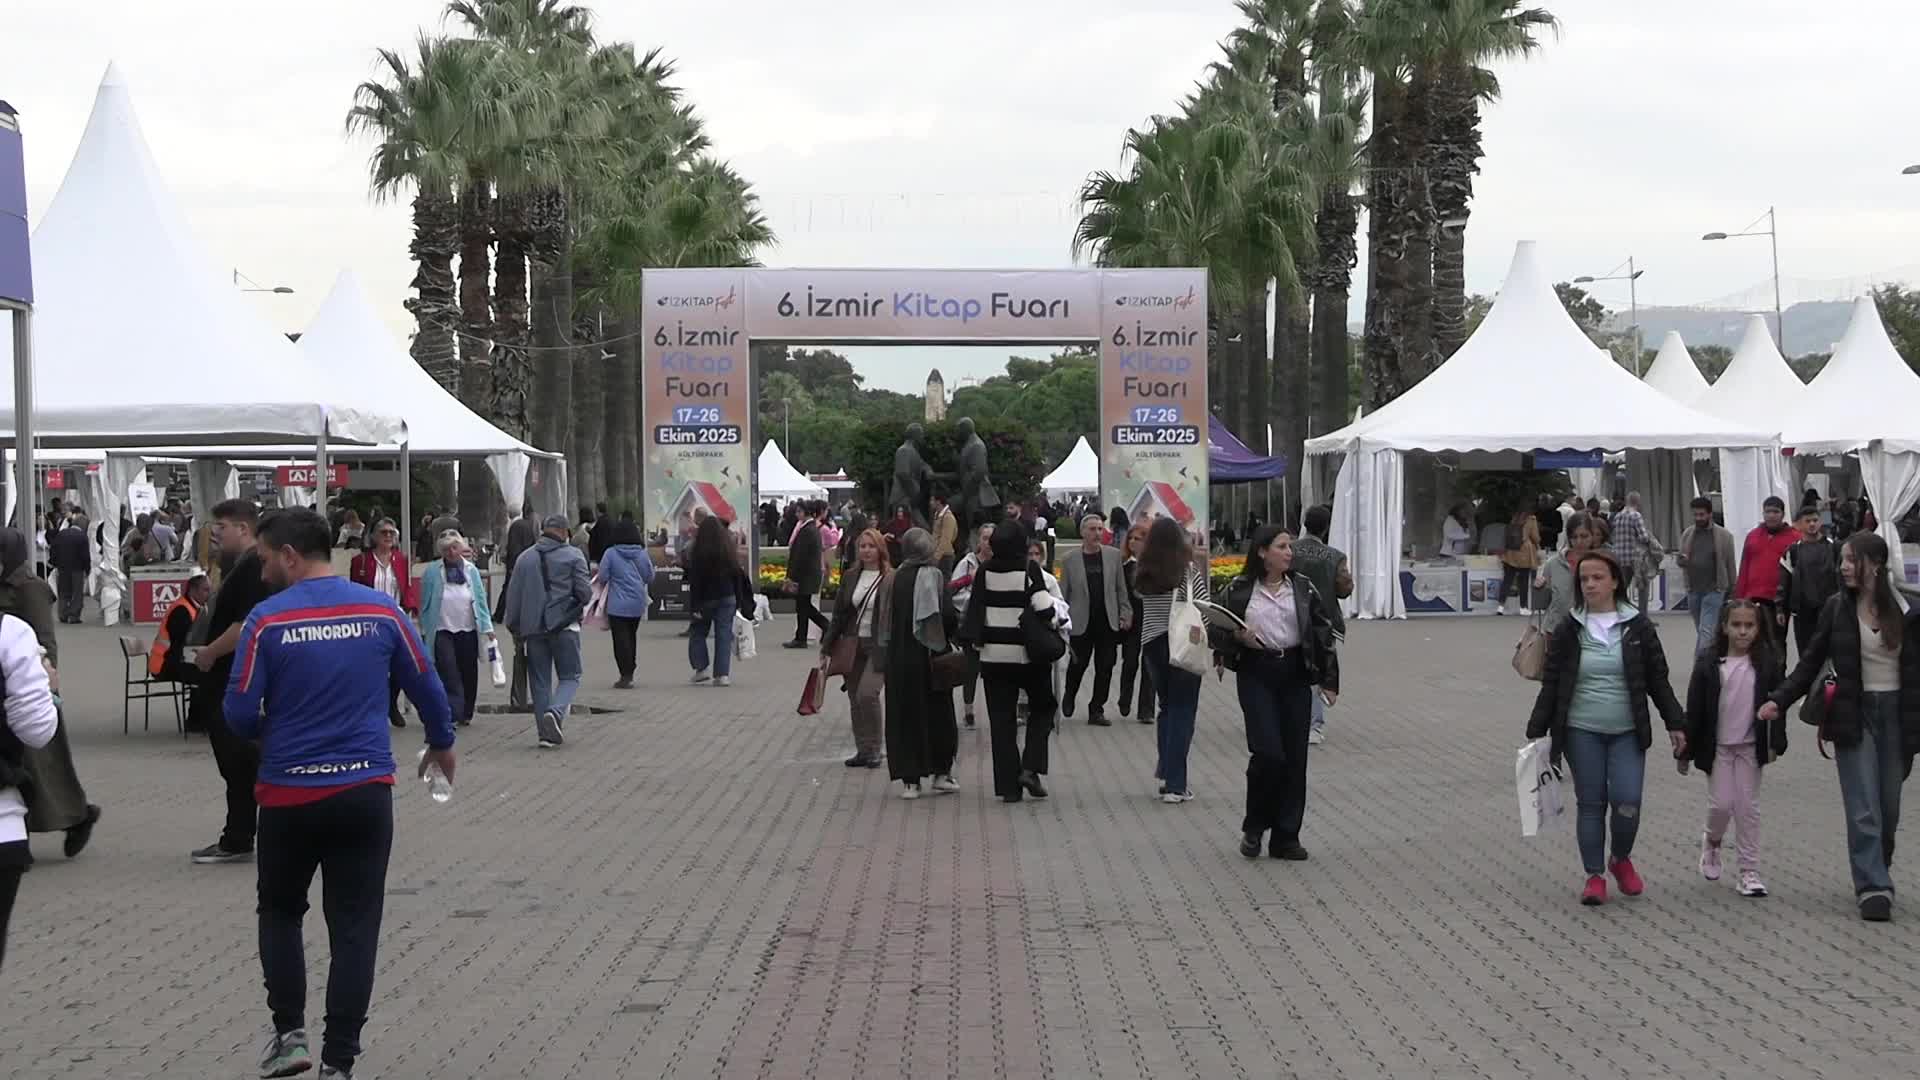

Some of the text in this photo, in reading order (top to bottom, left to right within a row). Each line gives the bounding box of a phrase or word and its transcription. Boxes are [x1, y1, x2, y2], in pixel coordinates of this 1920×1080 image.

[777, 285, 1069, 324] 6. İzmir Kitap Fuarı
[654, 320, 739, 346] 6. İzmir
[1112, 320, 1198, 346] 6. İzmir
[661, 351, 732, 375] Kitap
[1120, 351, 1191, 375] Kitap
[666, 376, 728, 397] Fuarı
[1124, 376, 1186, 397] Fuarı
[677, 408, 719, 422] 17-26
[1135, 408, 1177, 422] 17-26
[660, 428, 737, 442] Ekim 2025
[1117, 428, 1195, 442] Ekim 2025
[281, 622, 380, 644] ALTINORDU FK
